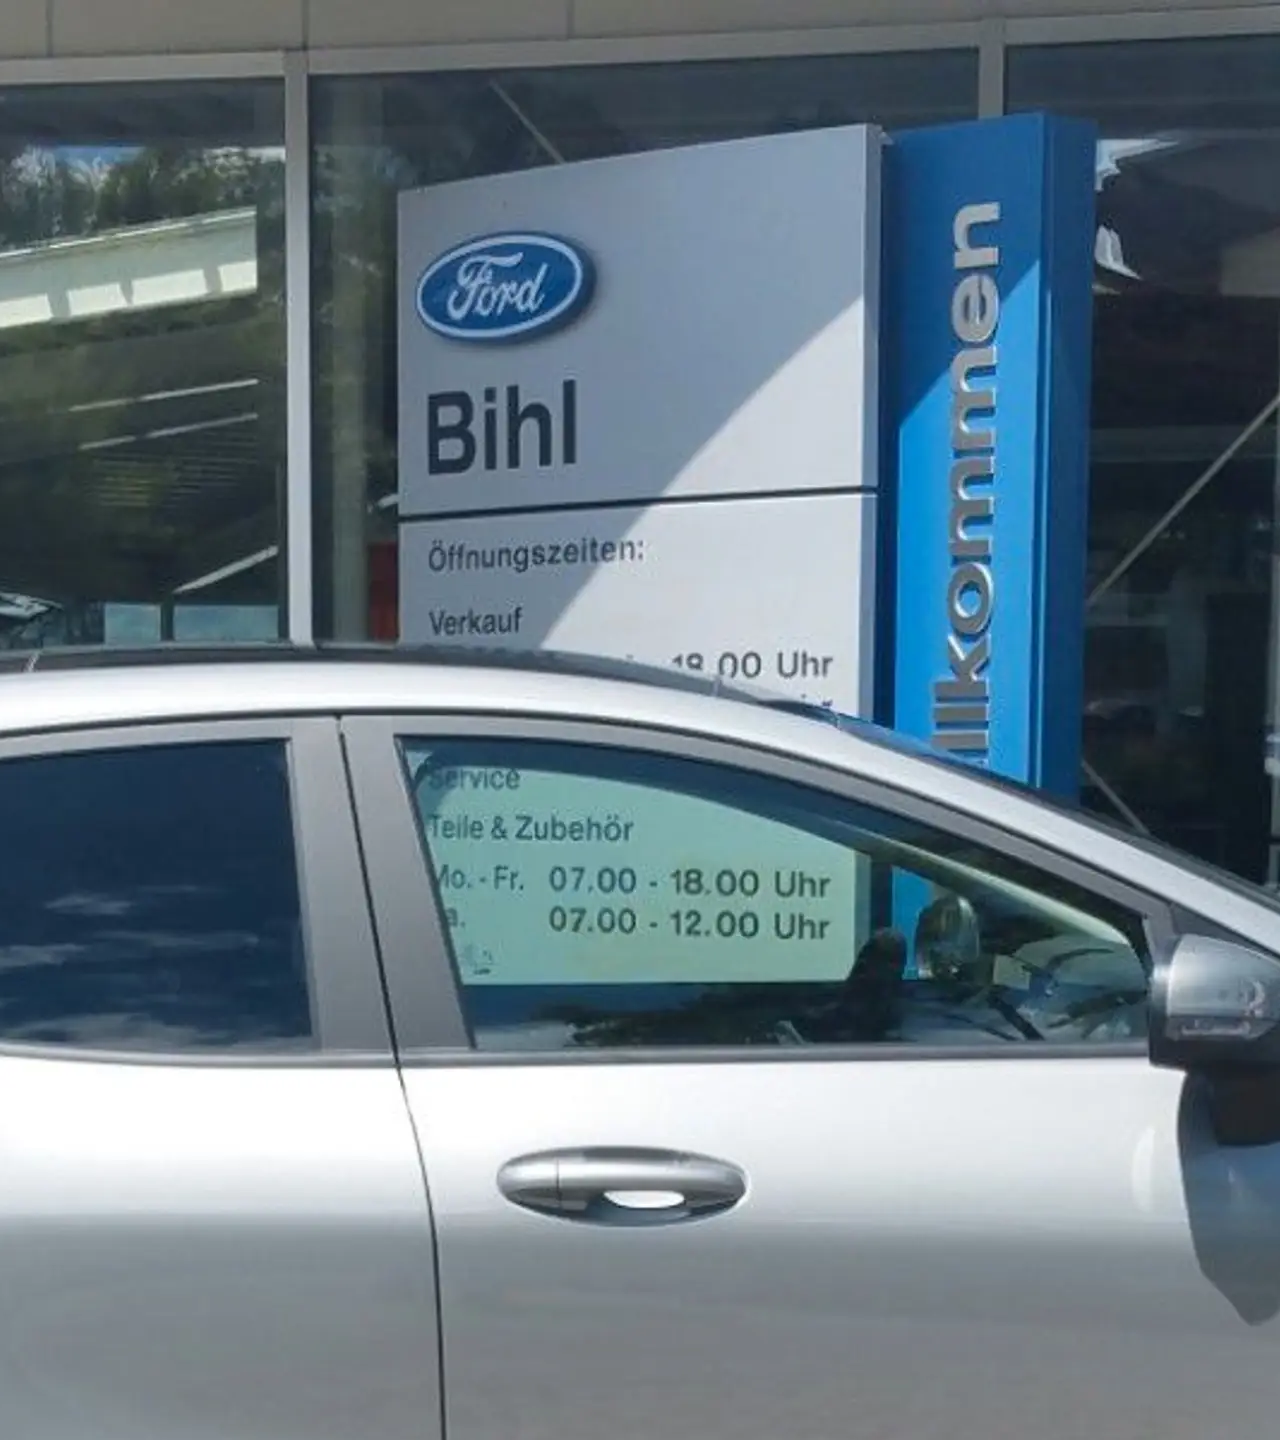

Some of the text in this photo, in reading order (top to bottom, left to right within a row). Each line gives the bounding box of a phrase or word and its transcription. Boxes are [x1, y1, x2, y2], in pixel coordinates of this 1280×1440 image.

[447, 252, 550, 321] Ford
[427, 379, 577, 475] Bihl
[932, 200, 1002, 762] llkommen
[428, 538, 645, 573] Öffnungszeiten:
[428, 606, 523, 636] Verkauf
[777, 650, 834, 679] Uhr
[428, 763, 521, 791] Service
[425, 811, 635, 843] Teile & Zubehör
[493, 864, 525, 891] Fr.
[548, 865, 637, 894] 07.00
[670, 868, 760, 897] 18.00
[774, 869, 832, 898] Uhr
[443, 907, 467, 929] a.
[548, 905, 637, 935] 07.00
[670, 909, 760, 939] 12.00
[774, 911, 832, 940] Uhr
